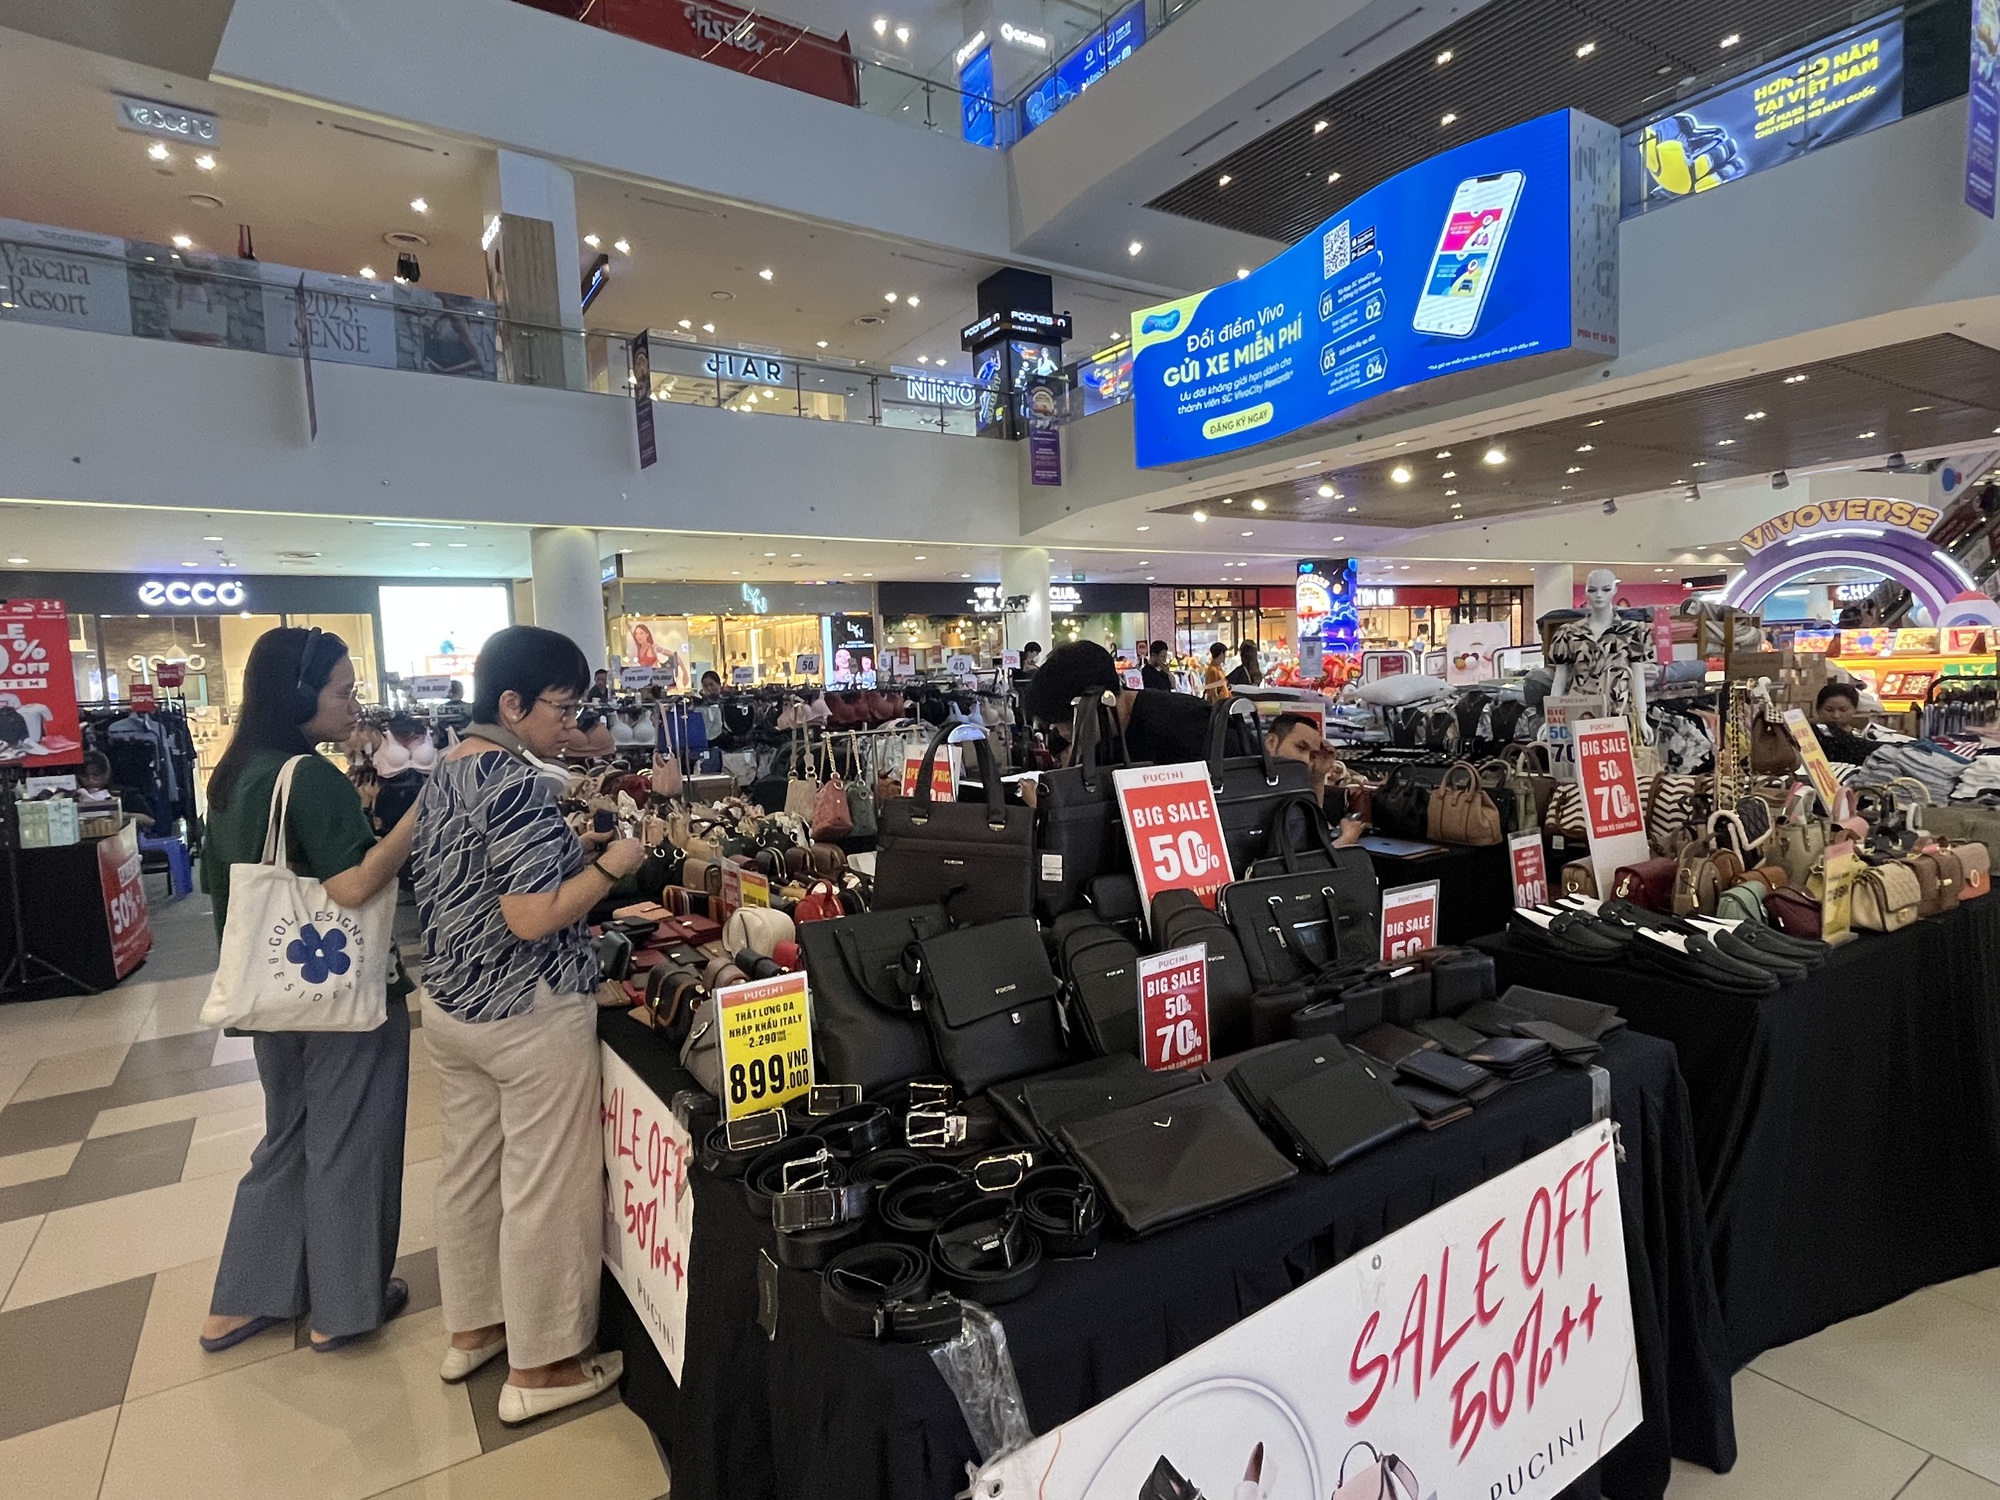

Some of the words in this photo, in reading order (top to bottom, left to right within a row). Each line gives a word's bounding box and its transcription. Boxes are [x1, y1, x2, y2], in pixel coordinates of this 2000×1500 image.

[1755, 95, 1784, 116] TẠI
[1832, 56, 1878, 86] NAM
[0, 242, 91, 285] Vascara
[8, 275, 89, 316] Resort
[1322, 299, 1333, 316] 01
[1366, 301, 1381, 320] 02
[1187, 327, 1215, 353] Đổi
[1218, 317, 1255, 343] điểm
[1257, 303, 1285, 326] Vivo
[1163, 356, 1200, 387] GỬI
[1206, 352, 1230, 378] XE
[1234, 329, 1275, 369] MIỄN
[1278, 311, 1303, 350] PHÍ
[1323, 352, 1336, 369] 03
[1366, 360, 1382, 379] 04
[1221, 392, 1233, 404] SC
[1209, 419, 1234, 435] ĐĂNG
[1235, 415, 1247, 429] KÝ
[1247, 409, 1268, 425] NGAY
[1739, 498, 1939, 550] VIVOVERSE
[138, 581, 244, 606] ecco
[741, 582, 767, 613] LYN
[846, 621, 864, 638] LYN
[11, 662, 50, 676] OFF
[1581, 740, 1600, 757] BIG
[1601, 737, 1627, 754] SALE
[1142, 771, 1184, 784] PUCINI
[1132, 805, 1165, 828] BIG
[1167, 800, 1210, 824] SALE
[1593, 784, 1636, 821] 70%
[1149, 830, 1220, 882] 50%
[1386, 921, 1404, 938] BIG
[1405, 915, 1431, 933] SALE
[1158, 954, 1188, 969] PUCINI
[743, 985, 783, 1001] PUCINI
[1147, 977, 1169, 998] BIG
[1171, 967, 1201, 990] SALE
[780, 1013, 803, 1027] ITALY
[782, 1001, 794, 1014] DA
[1156, 1019, 1201, 1063] 70%
[787, 1048, 808, 1069] VND
[730, 1054, 785, 1104] 899
[786, 1068, 809, 1090] .000
[648, 1120, 686, 1222] OFF
[624, 1179, 684, 1292] 50%++
[1345, 1217, 1506, 1427] SALE
[1520, 1142, 1611, 1290] OFF
[637, 1277, 675, 1355] PUCINI
[1450, 1282, 1603, 1466] 50%++
[1490, 1418, 1584, 1500] PUCINI
